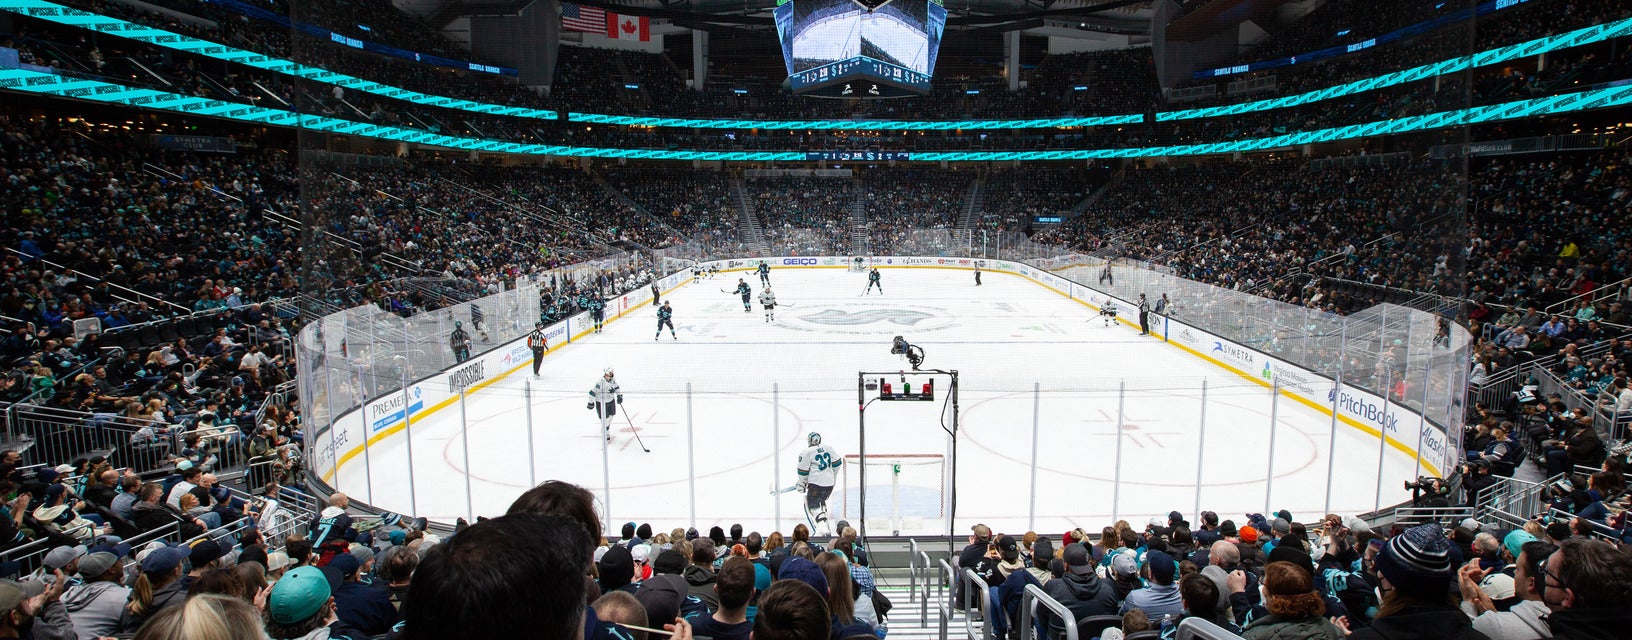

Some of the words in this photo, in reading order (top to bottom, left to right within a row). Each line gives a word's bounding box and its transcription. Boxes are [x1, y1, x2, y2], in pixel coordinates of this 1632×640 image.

[27, 6, 59, 16] IMPOSSIBLE
[25, 75, 58, 87] IMPOSSIBLE
[783, 258, 818, 266] GEICO
[1223, 344, 1254, 364] SYMETRA
[449, 359, 485, 394] IMPOSSIBLE
[1296, 382, 1315, 396] Health
[372, 393, 413, 419] PREMEA
[1339, 391, 1399, 433] PitchBook
[312, 523, 332, 549] 7
